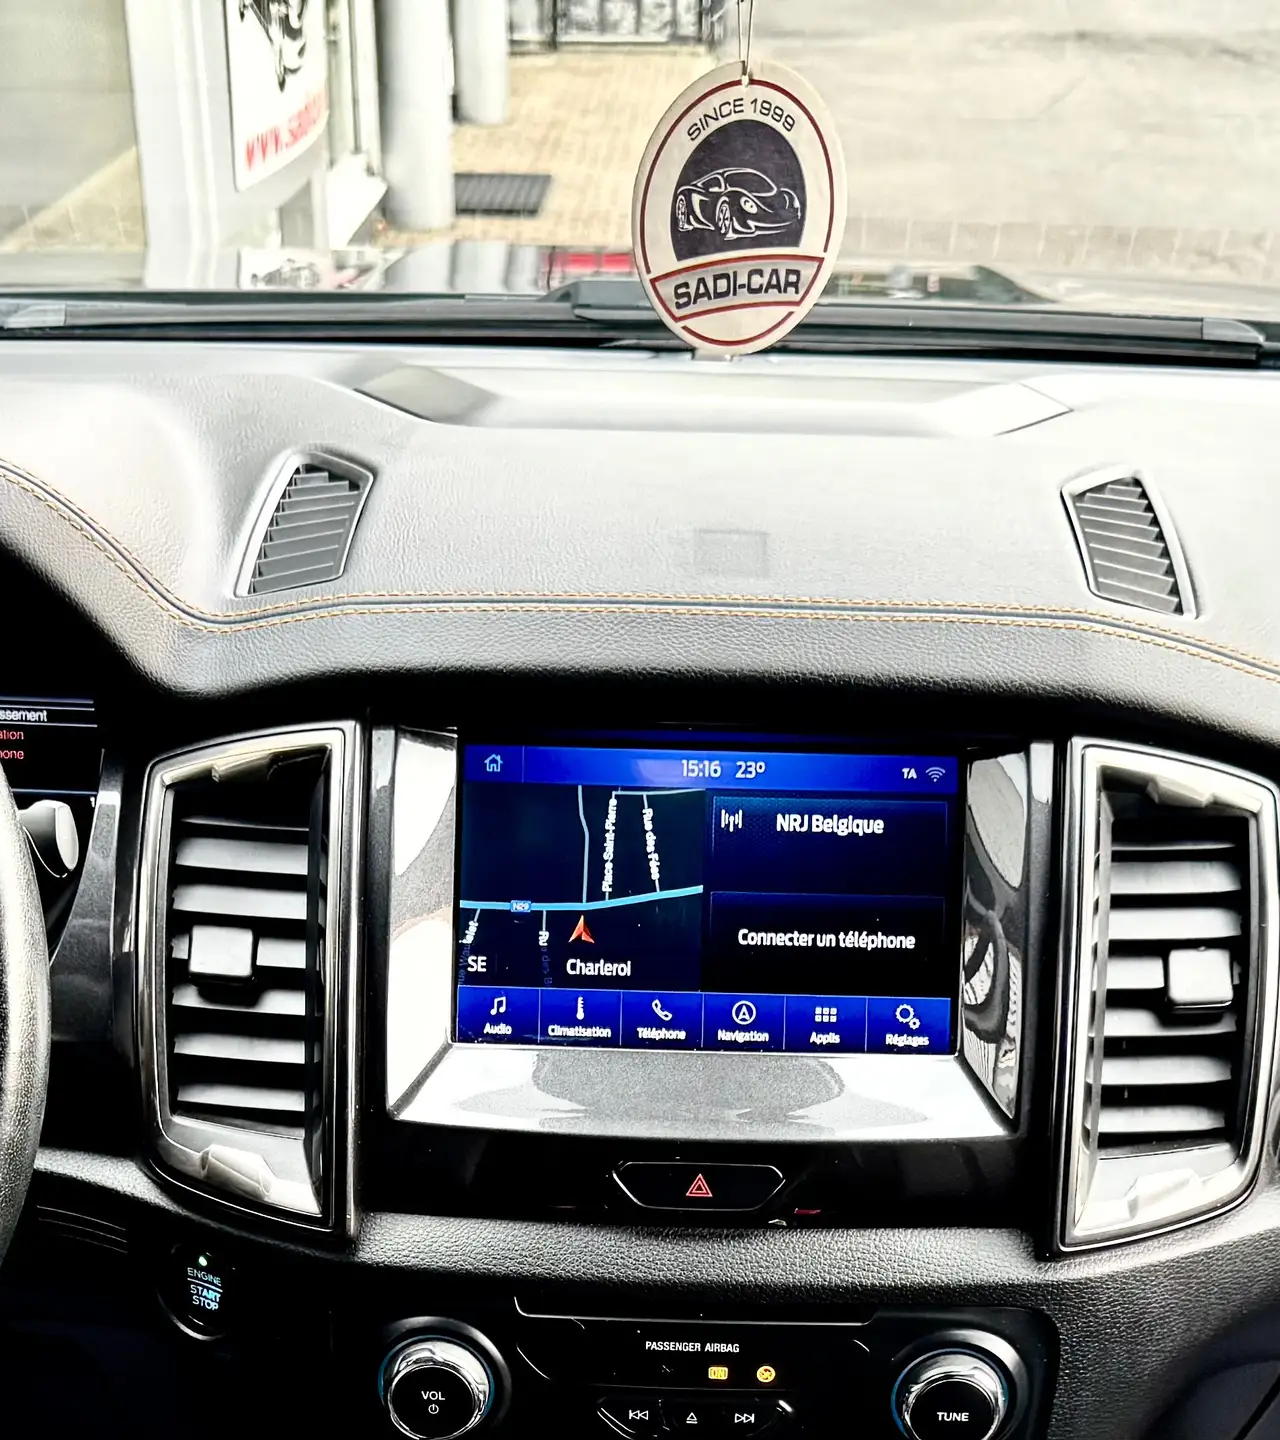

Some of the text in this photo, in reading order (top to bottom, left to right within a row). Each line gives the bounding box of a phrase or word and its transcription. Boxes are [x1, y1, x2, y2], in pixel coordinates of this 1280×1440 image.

[687, 98, 796, 141] SINCE 1999
[673, 269, 801, 310] SADI-CAR
[681, 759, 722, 778] 15:16
[902, 767, 918, 780] TA
[642, 808, 654, 831] Rue
[776, 812, 885, 837] NRJ Belgique
[601, 861, 614, 893] Place
[738, 928, 916, 951] Connecter un téléphone
[467, 956, 487, 972] SE
[566, 959, 632, 977] Charleroi
[483, 1022, 512, 1035] Audio
[548, 1024, 612, 1038] Climatisation
[637, 1026, 686, 1041] Téléphone
[717, 1029, 769, 1043] Navigation
[809, 1031, 841, 1045] Applis
[885, 1032, 930, 1047] Réglages
[187, 1267, 222, 1286] ENGINE
[190, 1284, 222, 1302] START
[192, 1295, 219, 1311] STOP
[645, 1341, 740, 1353] PASSENGER AIRBAG
[421, 1390, 446, 1401] VOL
[936, 1411, 970, 1422] TUNE
